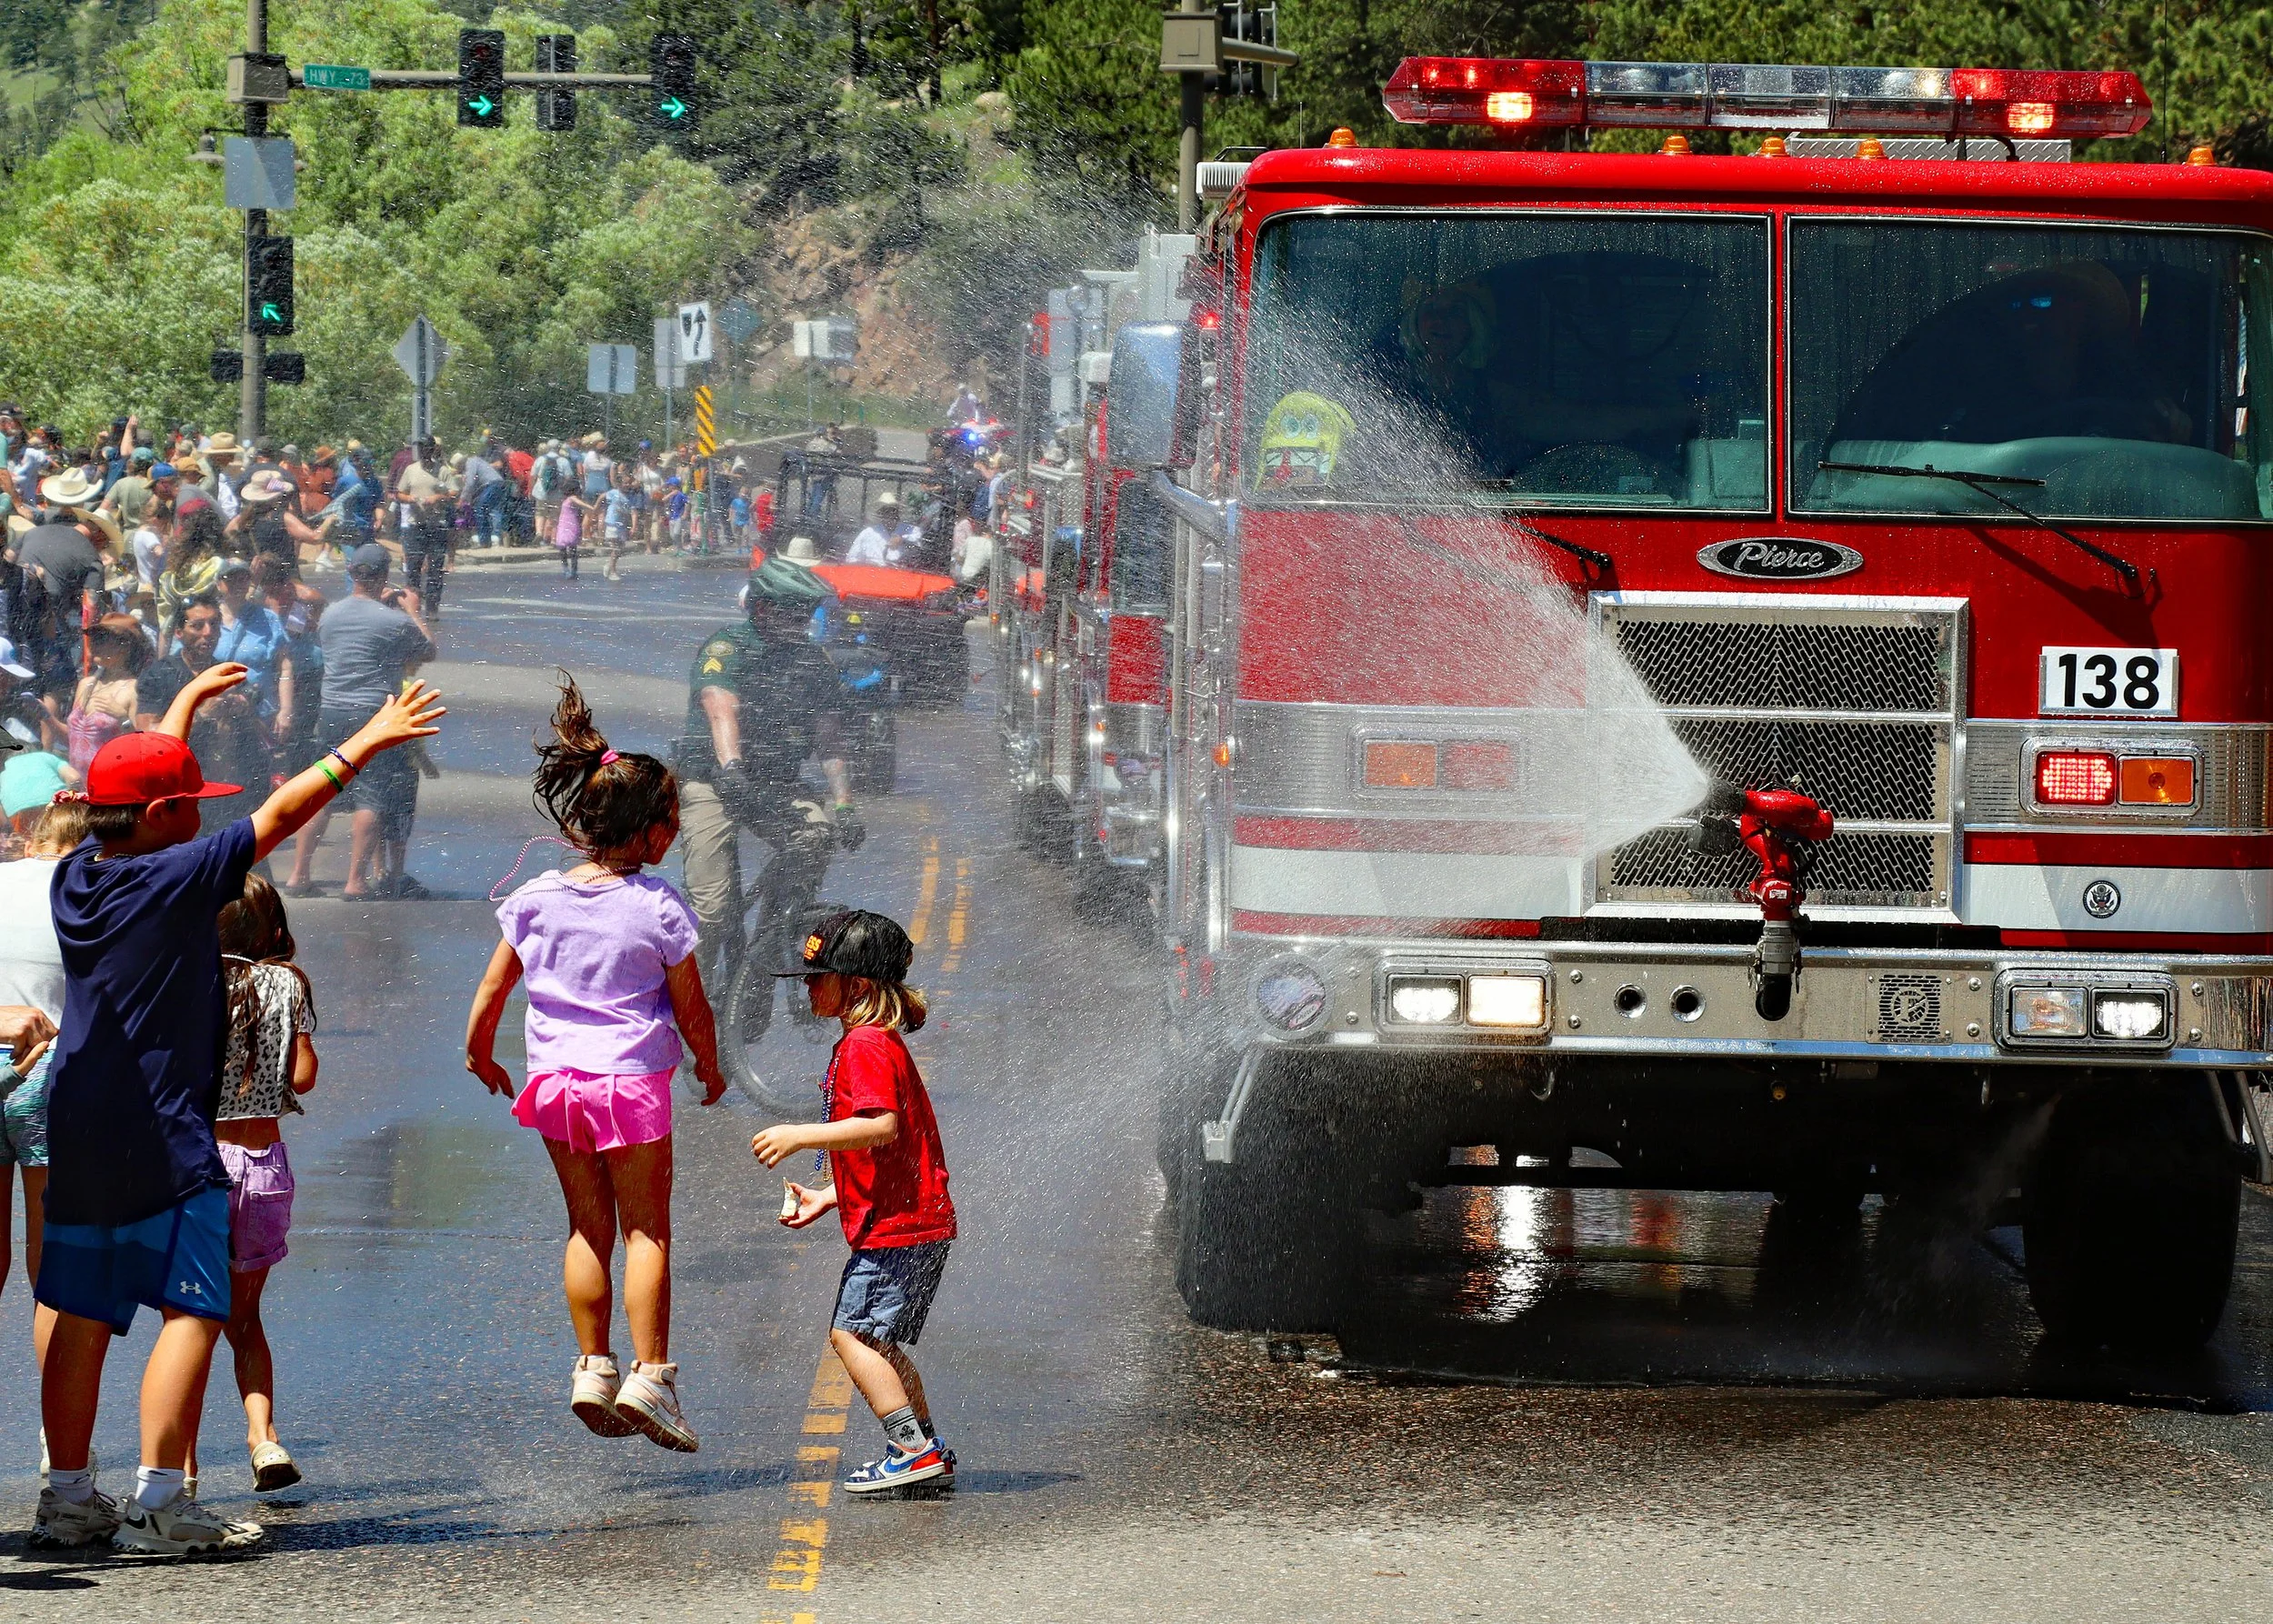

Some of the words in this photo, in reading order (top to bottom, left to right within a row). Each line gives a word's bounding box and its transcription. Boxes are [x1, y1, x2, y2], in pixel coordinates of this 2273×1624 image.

[309, 68, 335, 85] HWY
[1733, 542, 1825, 571] Pierce
[2058, 653, 2159, 709] 138
[729, 995, 739, 1025] GROUND
